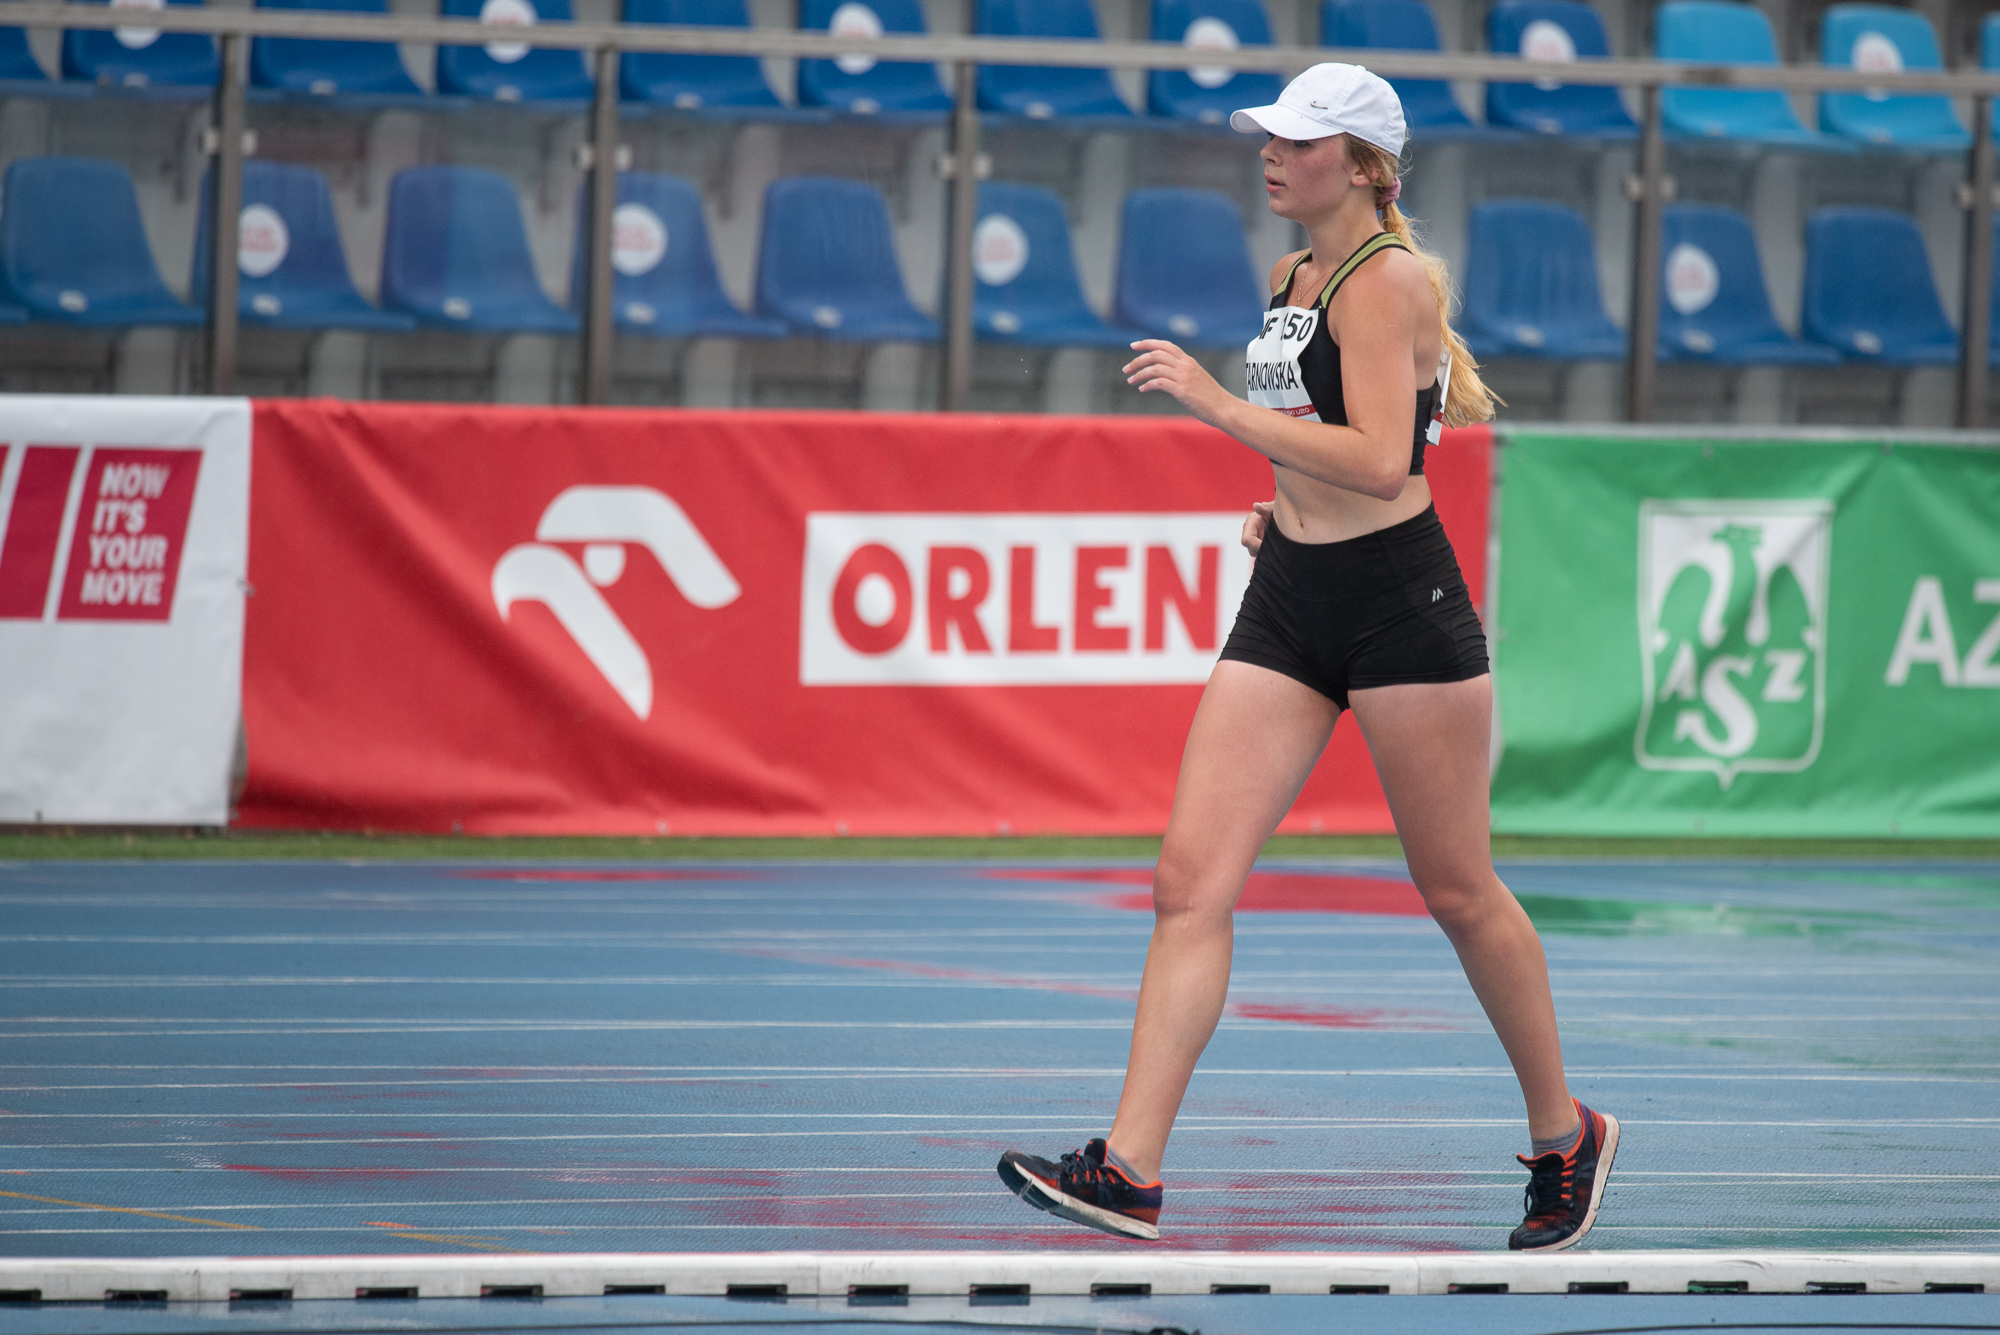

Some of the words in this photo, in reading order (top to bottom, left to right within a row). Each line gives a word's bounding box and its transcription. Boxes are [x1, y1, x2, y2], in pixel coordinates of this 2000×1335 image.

[99, 463, 171, 498] NOW
[92, 500, 147, 533] IT'S
[89, 534, 168, 569] YOUR
[80, 571, 164, 606] MOVE
[831, 541, 1221, 658] ORLEN
